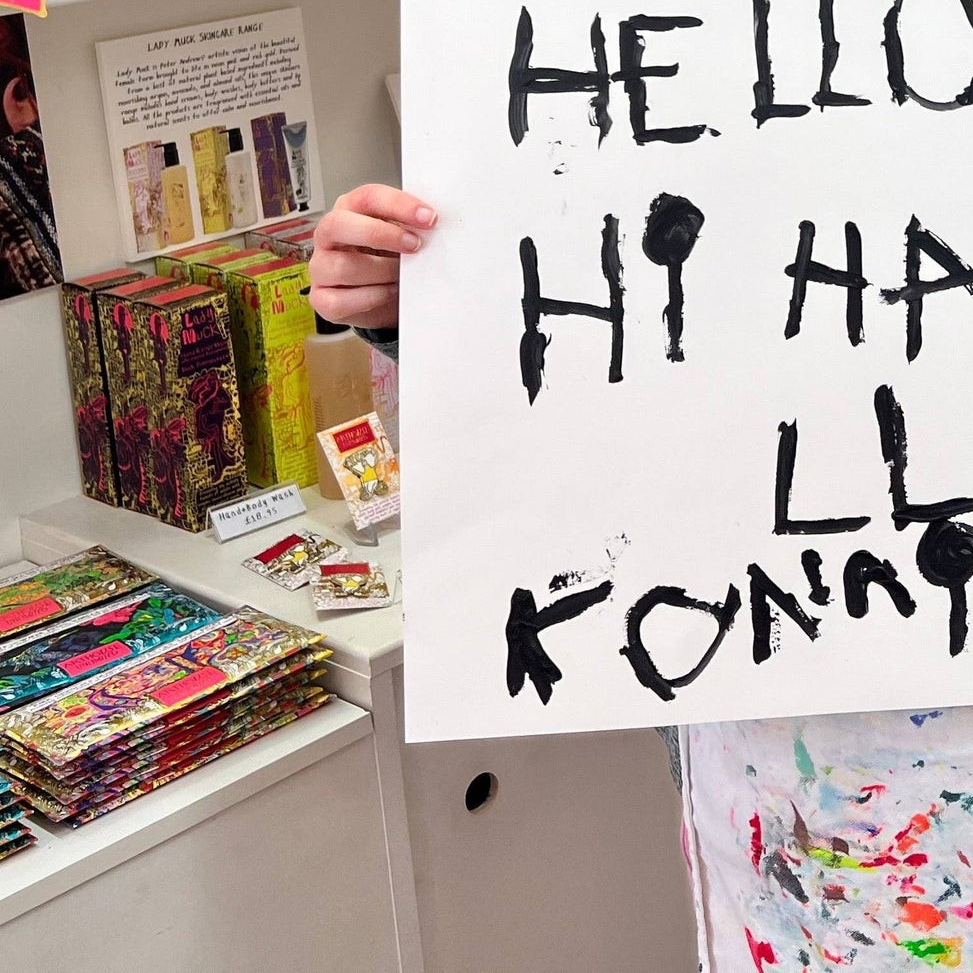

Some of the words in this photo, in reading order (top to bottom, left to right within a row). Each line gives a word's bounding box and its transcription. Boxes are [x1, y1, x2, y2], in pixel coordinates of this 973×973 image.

[147, 40, 170, 52] LADY
[174, 34, 196, 47] MUCK
[238, 22, 263, 35] RANGE
[184, 307, 215, 328] Lady
[182, 325, 220, 345] Muck
[271, 489, 294, 503] Wash
[245, 507, 278, 525] £18.95
